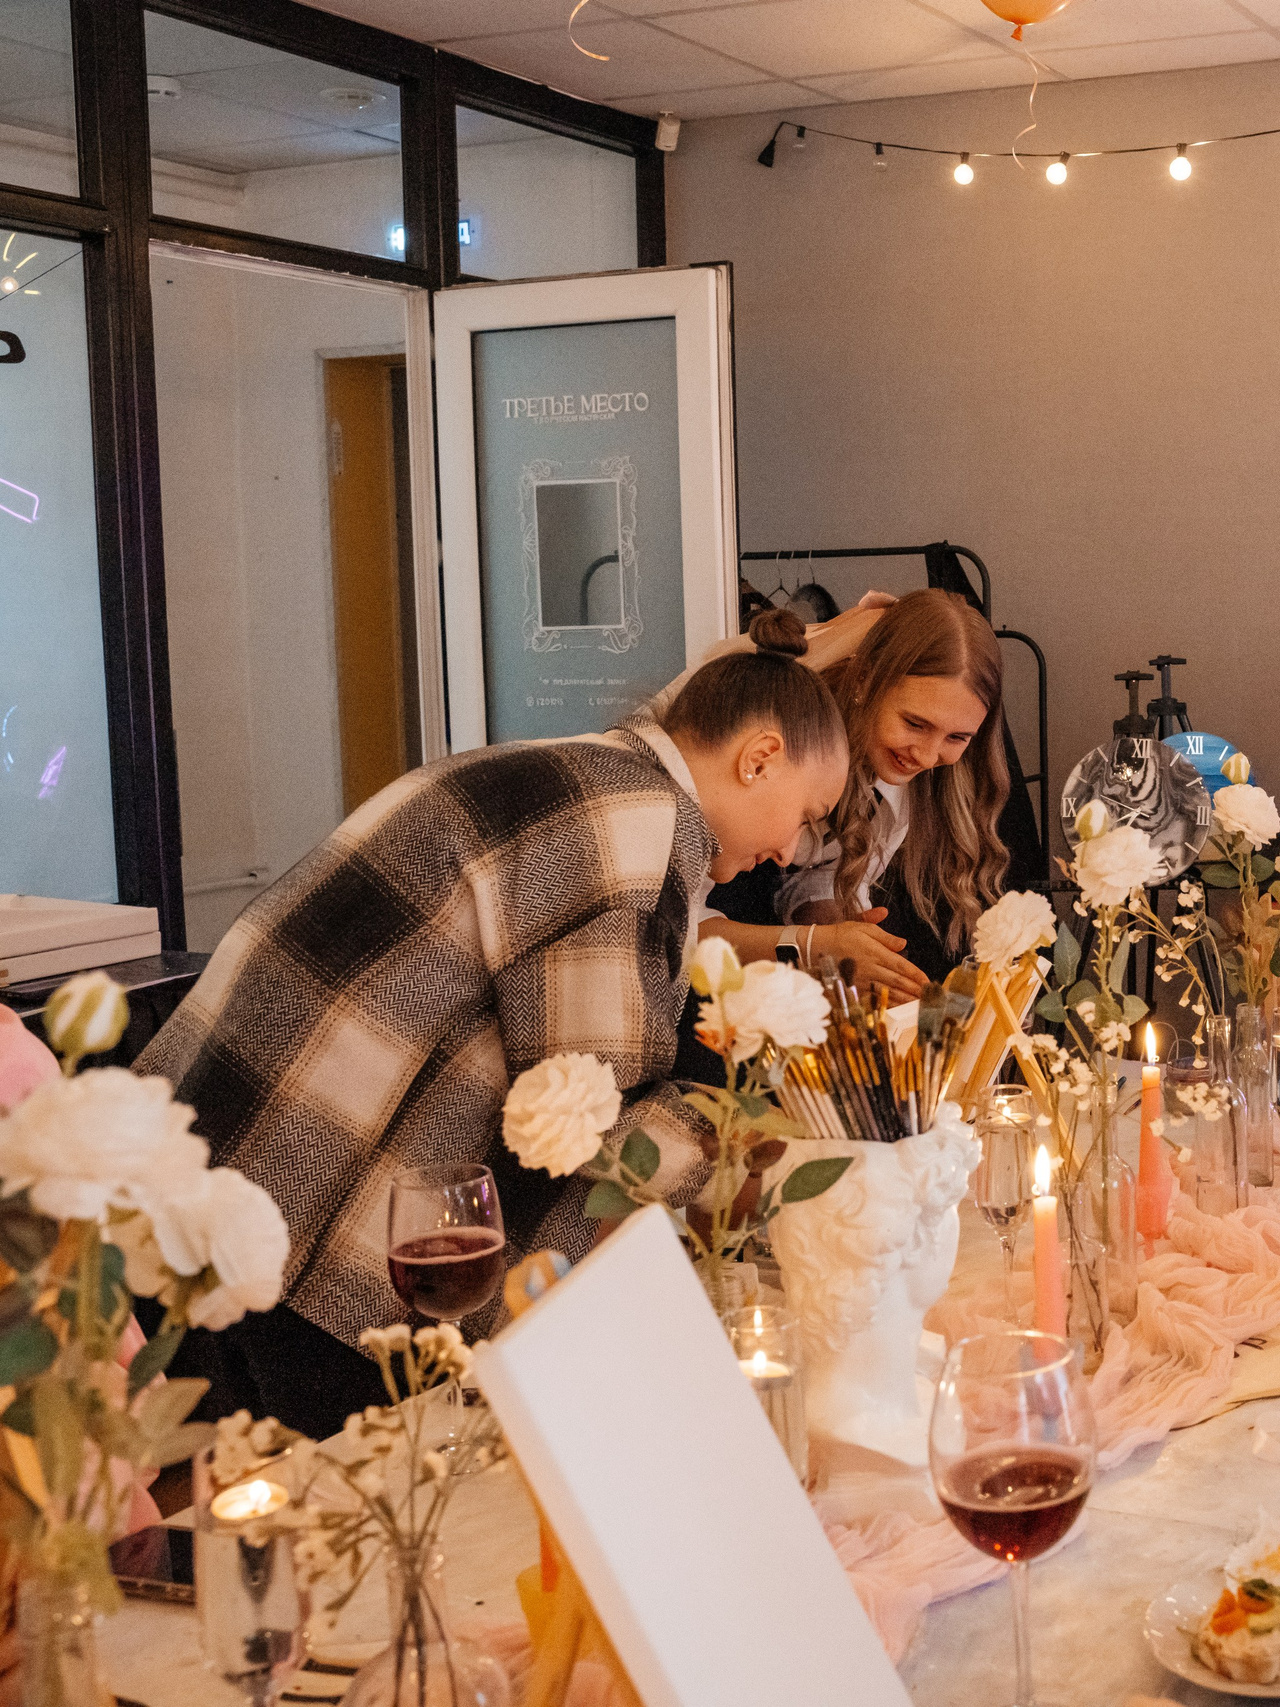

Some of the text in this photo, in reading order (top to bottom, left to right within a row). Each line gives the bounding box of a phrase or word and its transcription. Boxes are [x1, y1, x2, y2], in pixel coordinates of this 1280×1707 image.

[502, 392, 649, 418] ТРЕТЬЕ МЕСТО
[1132, 738, 1152, 759] XII
[1186, 736, 1204, 755] XII
[1062, 797, 1077, 818] IX
[1196, 805, 1210, 826] III
